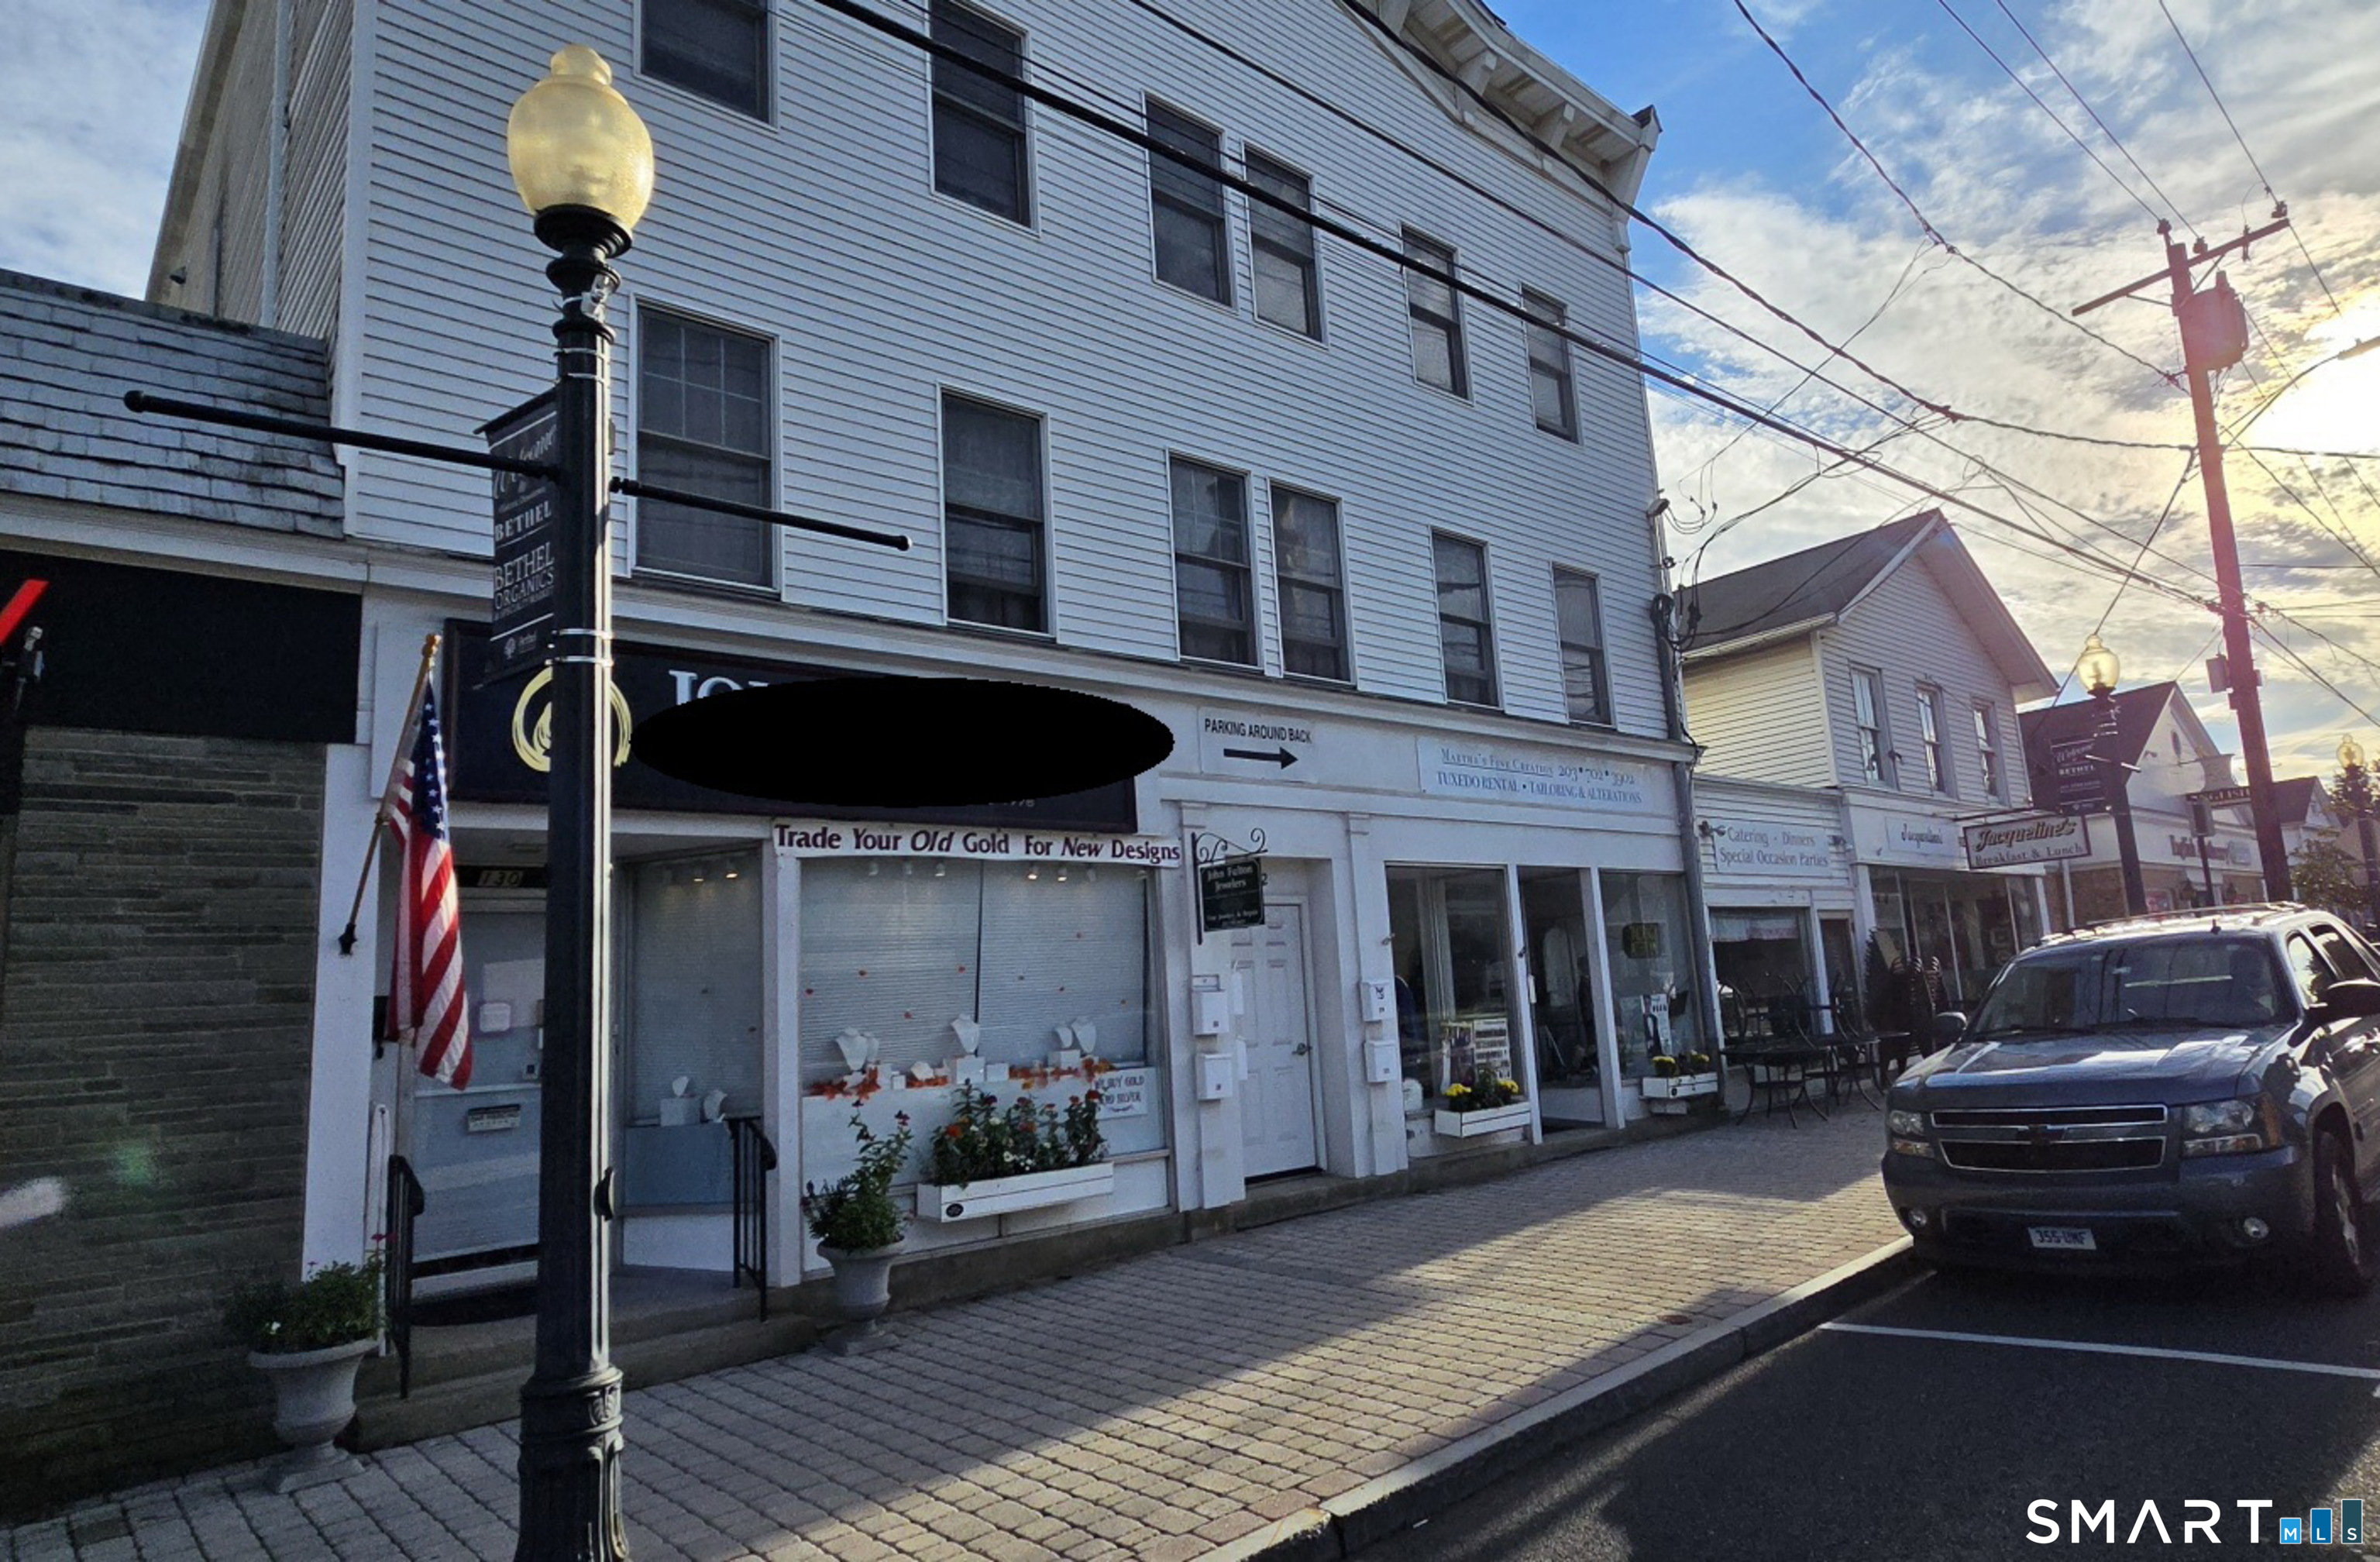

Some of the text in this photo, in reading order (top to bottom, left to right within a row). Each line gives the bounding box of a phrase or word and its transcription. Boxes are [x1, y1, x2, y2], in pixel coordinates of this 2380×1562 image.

[494, 501, 552, 542] BETHEL
[494, 541, 555, 592] BETHEL
[494, 566, 555, 610] ORGANICS
[1205, 717, 1312, 745] PARKING AROUND BACK
[1436, 771, 1480, 789] TUXEDO
[1481, 776, 1520, 793] RENTAL
[1587, 786, 1642, 803] ALTERATIONS
[774, 824, 1181, 865] Trade Your Old Gold For New Designs
[1727, 826, 1815, 847] Catering Dinners
[1976, 817, 2078, 852] Jacqueline's
[1719, 847, 1829, 867] Special Occasion Parties
[1975, 843, 2083, 867] Breakfast & Lunch
[482, 871, 520, 886] 130
